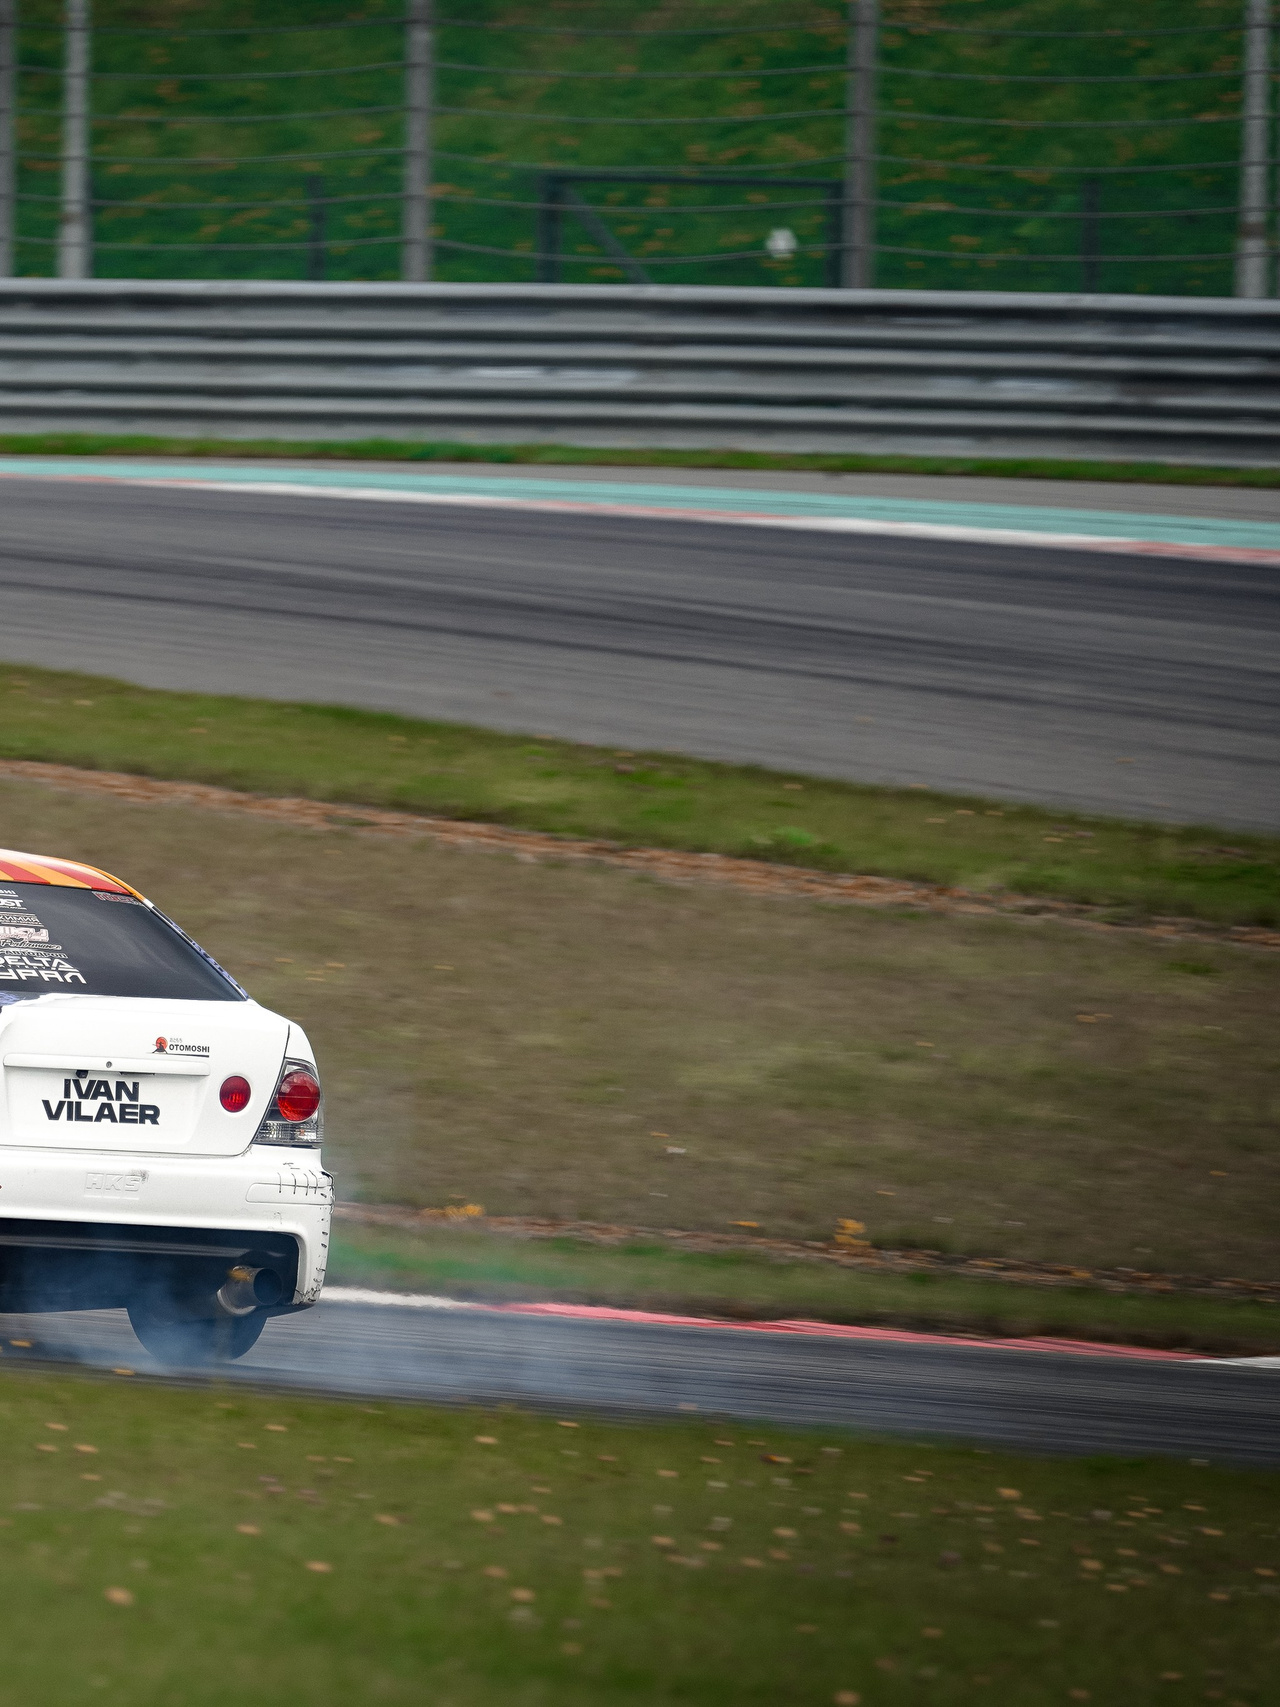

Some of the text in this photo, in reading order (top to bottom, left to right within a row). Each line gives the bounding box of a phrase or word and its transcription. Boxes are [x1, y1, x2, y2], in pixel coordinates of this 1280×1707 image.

[169, 1043, 210, 1053] OTOMOSHI
[63, 1078, 140, 1103] IVAN
[42, 1099, 161, 1125] VILAER
[85, 1172, 141, 1192] HKS
